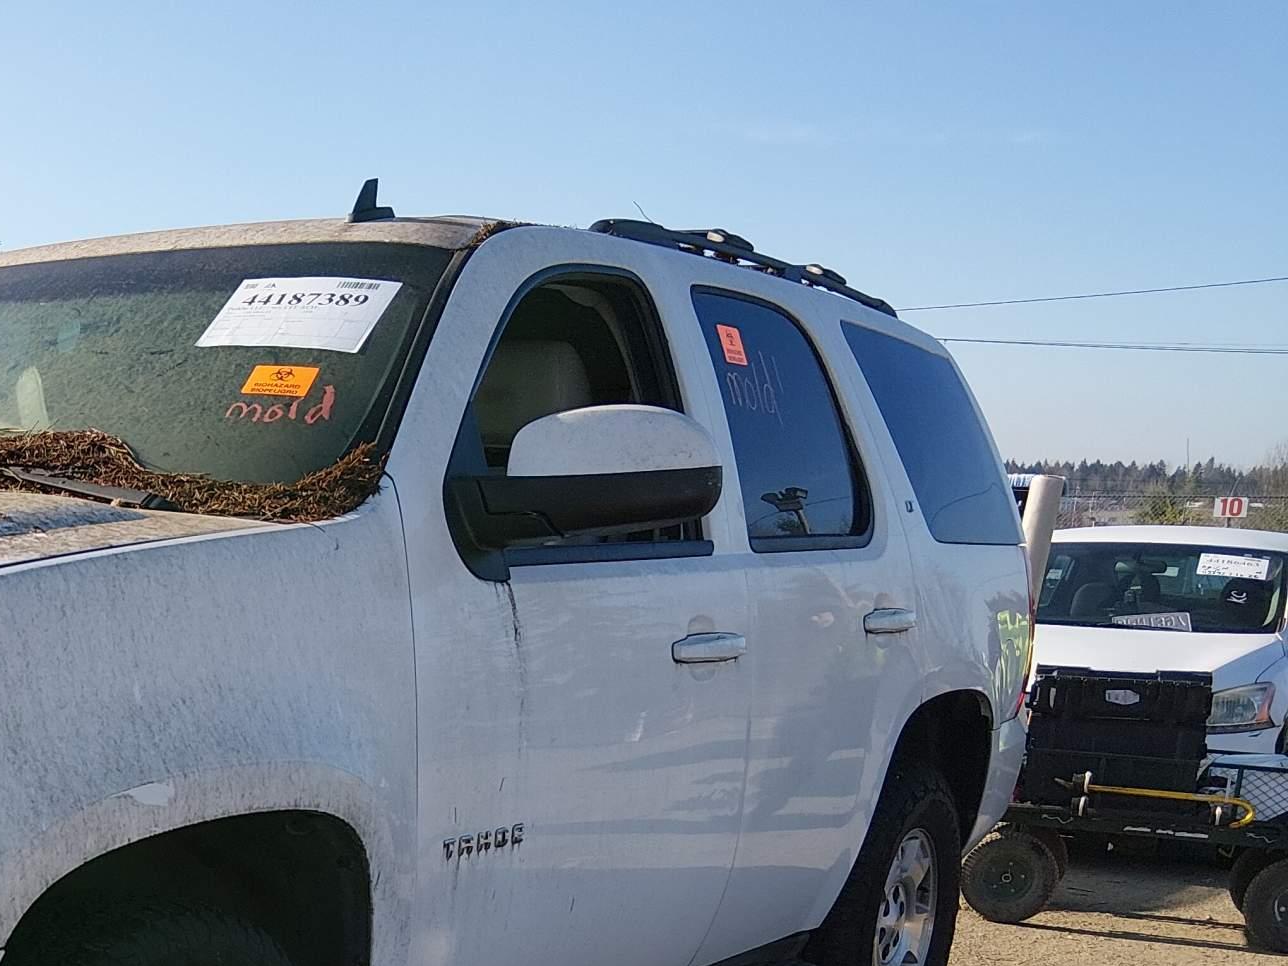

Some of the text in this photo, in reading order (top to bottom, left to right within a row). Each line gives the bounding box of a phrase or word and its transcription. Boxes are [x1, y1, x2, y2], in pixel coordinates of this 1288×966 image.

[241, 292, 369, 307] 44187389
[225, 384, 336, 425] mold
[1220, 498, 1243, 517] 10
[1226, 590, 1248, 604] KC
